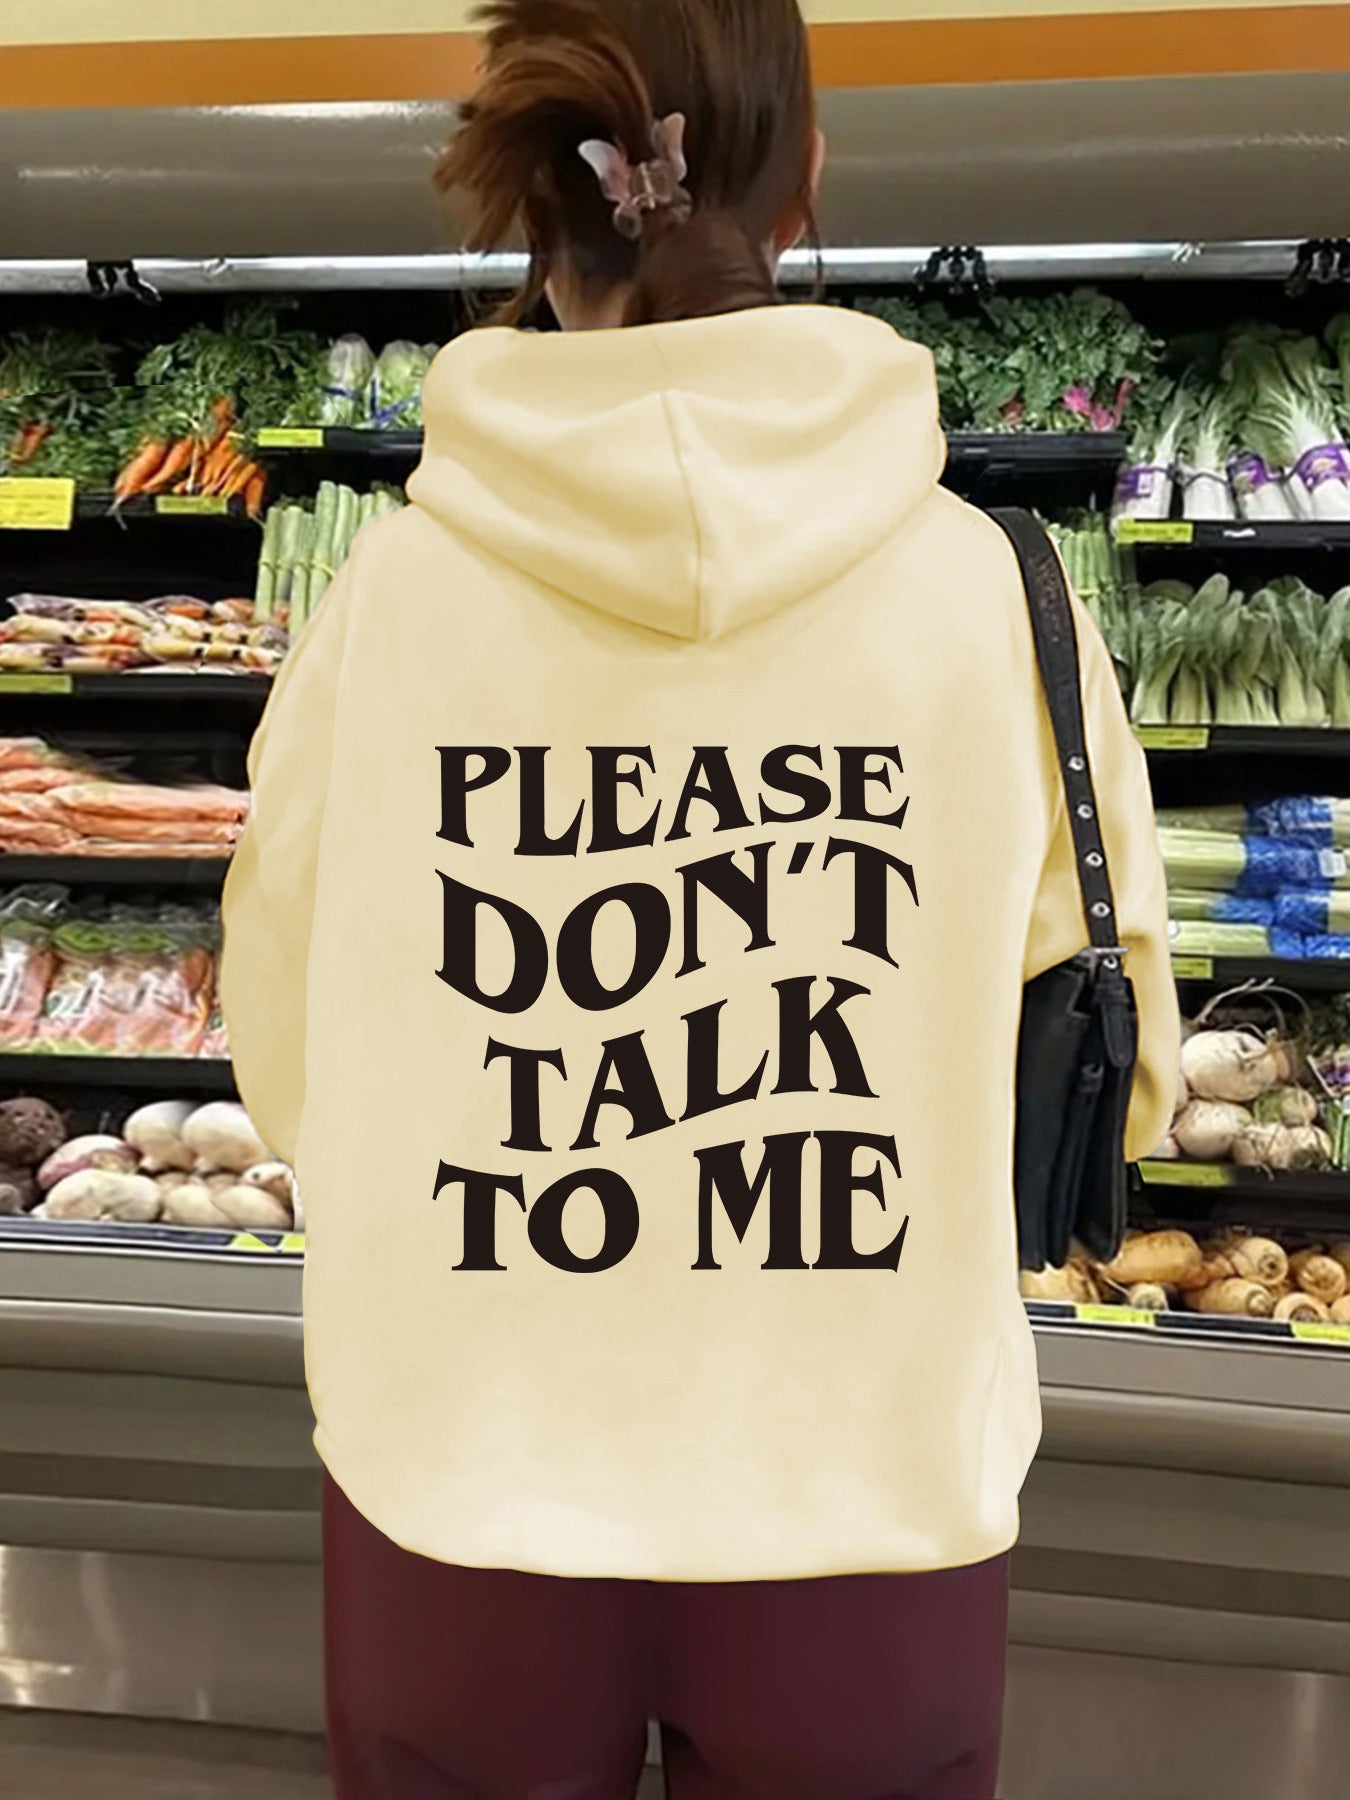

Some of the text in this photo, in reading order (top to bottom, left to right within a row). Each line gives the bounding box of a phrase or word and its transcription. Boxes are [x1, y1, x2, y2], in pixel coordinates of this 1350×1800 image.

[434, 745, 910, 858] PLEASE
[434, 836, 919, 1014] DON'T
[484, 976, 880, 1152] TALK
[433, 1131, 910, 1274] TO ME
